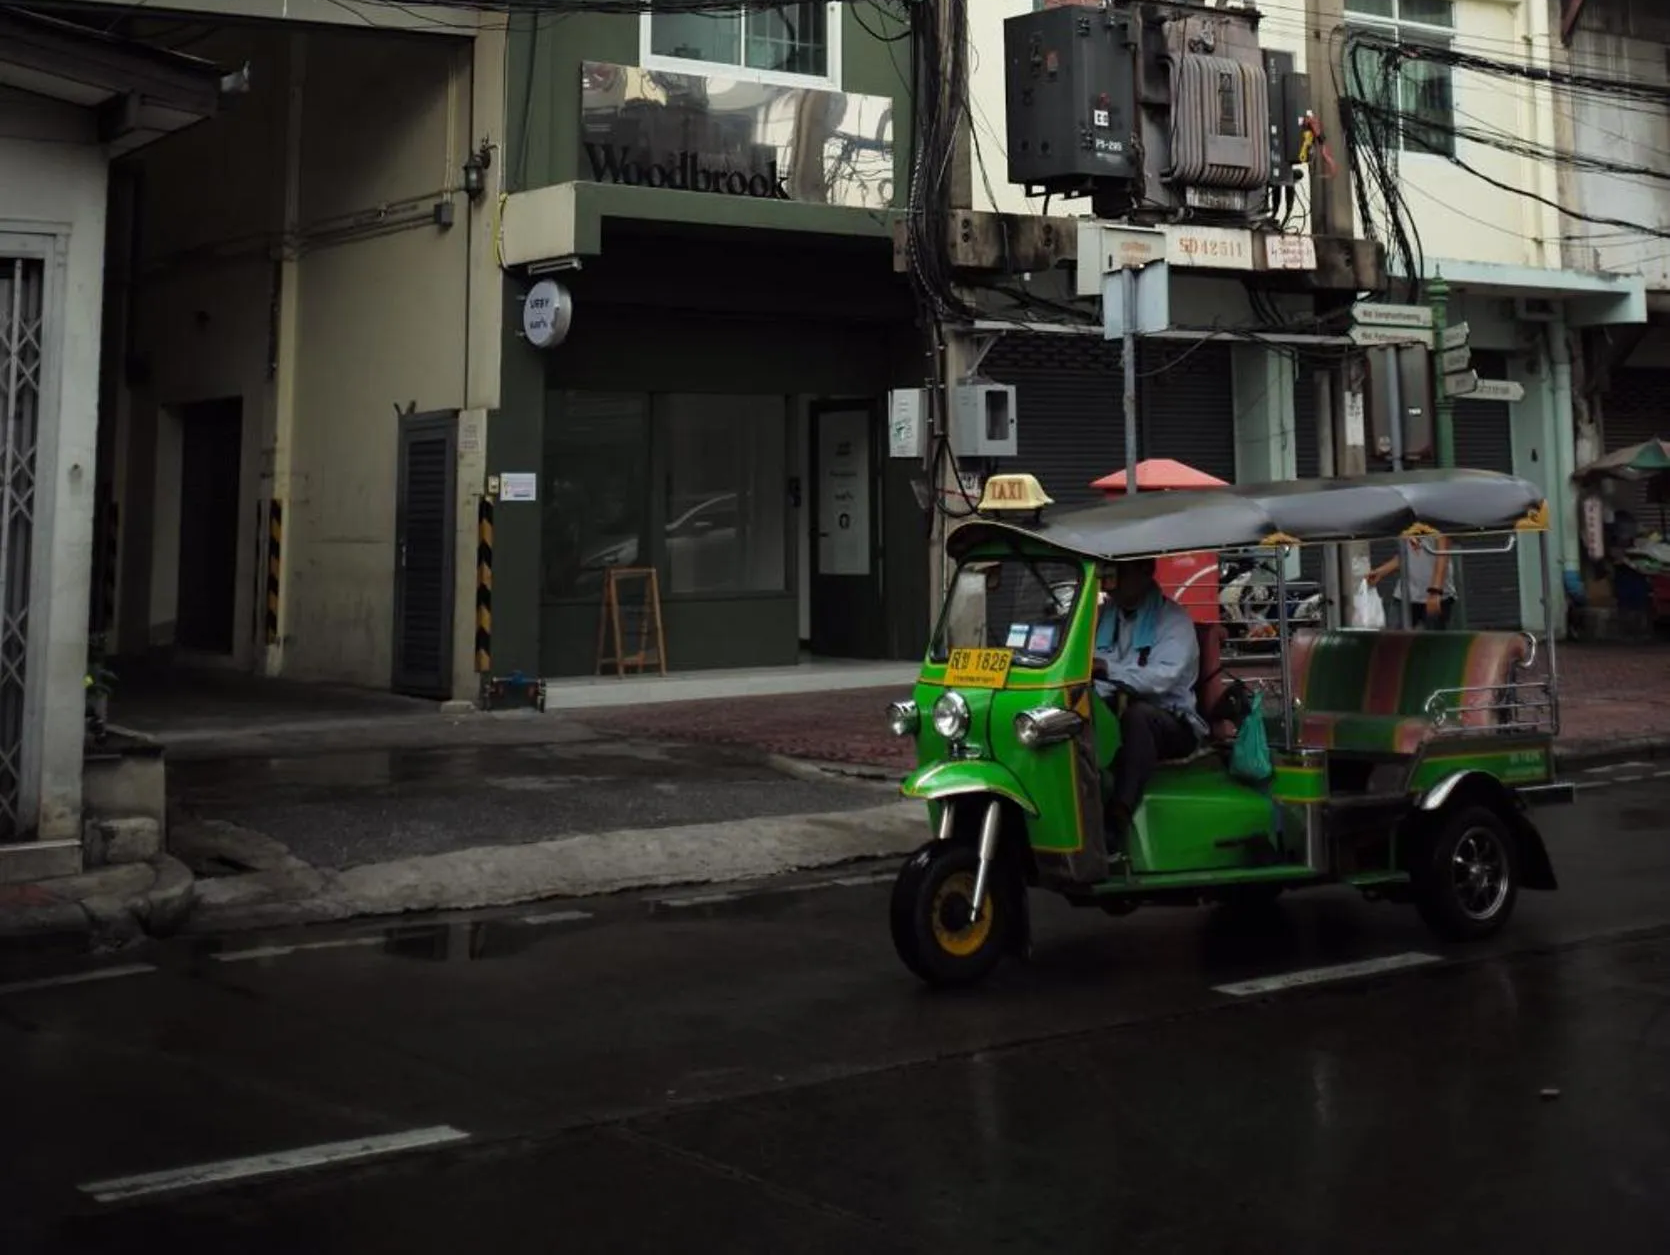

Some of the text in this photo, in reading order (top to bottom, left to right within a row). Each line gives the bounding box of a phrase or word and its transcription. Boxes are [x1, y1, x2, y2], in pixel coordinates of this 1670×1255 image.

[583, 141, 792, 200] Woodbrook
[991, 480, 1023, 500] TAXI
[975, 652, 1010, 672] 1826
